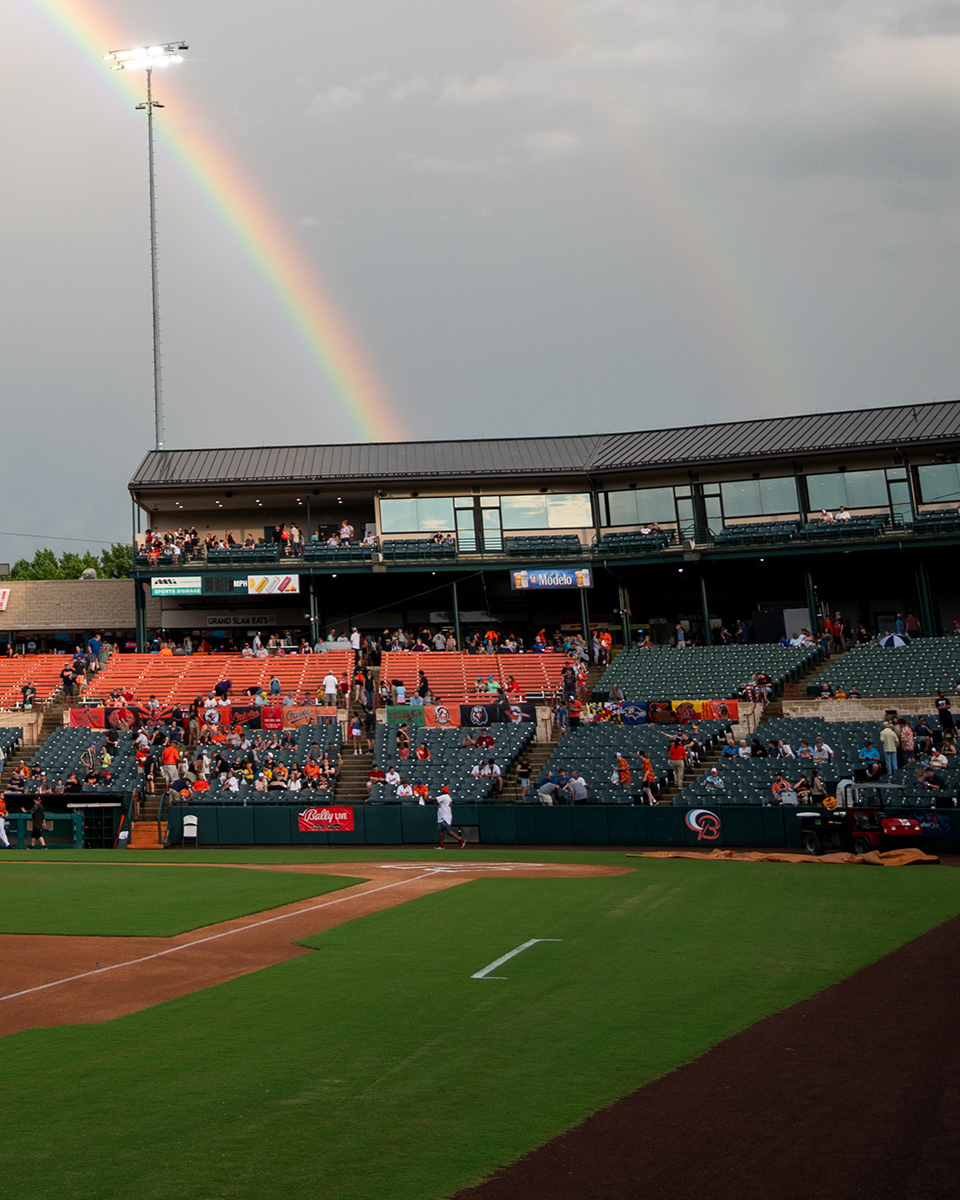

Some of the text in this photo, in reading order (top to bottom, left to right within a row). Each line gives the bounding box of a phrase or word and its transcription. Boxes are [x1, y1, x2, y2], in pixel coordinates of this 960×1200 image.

[538, 574, 573, 586] Modelo
[208, 615, 268, 625] GRAND SLAM EATS
[299, 808, 348, 824] Bally LIVE
